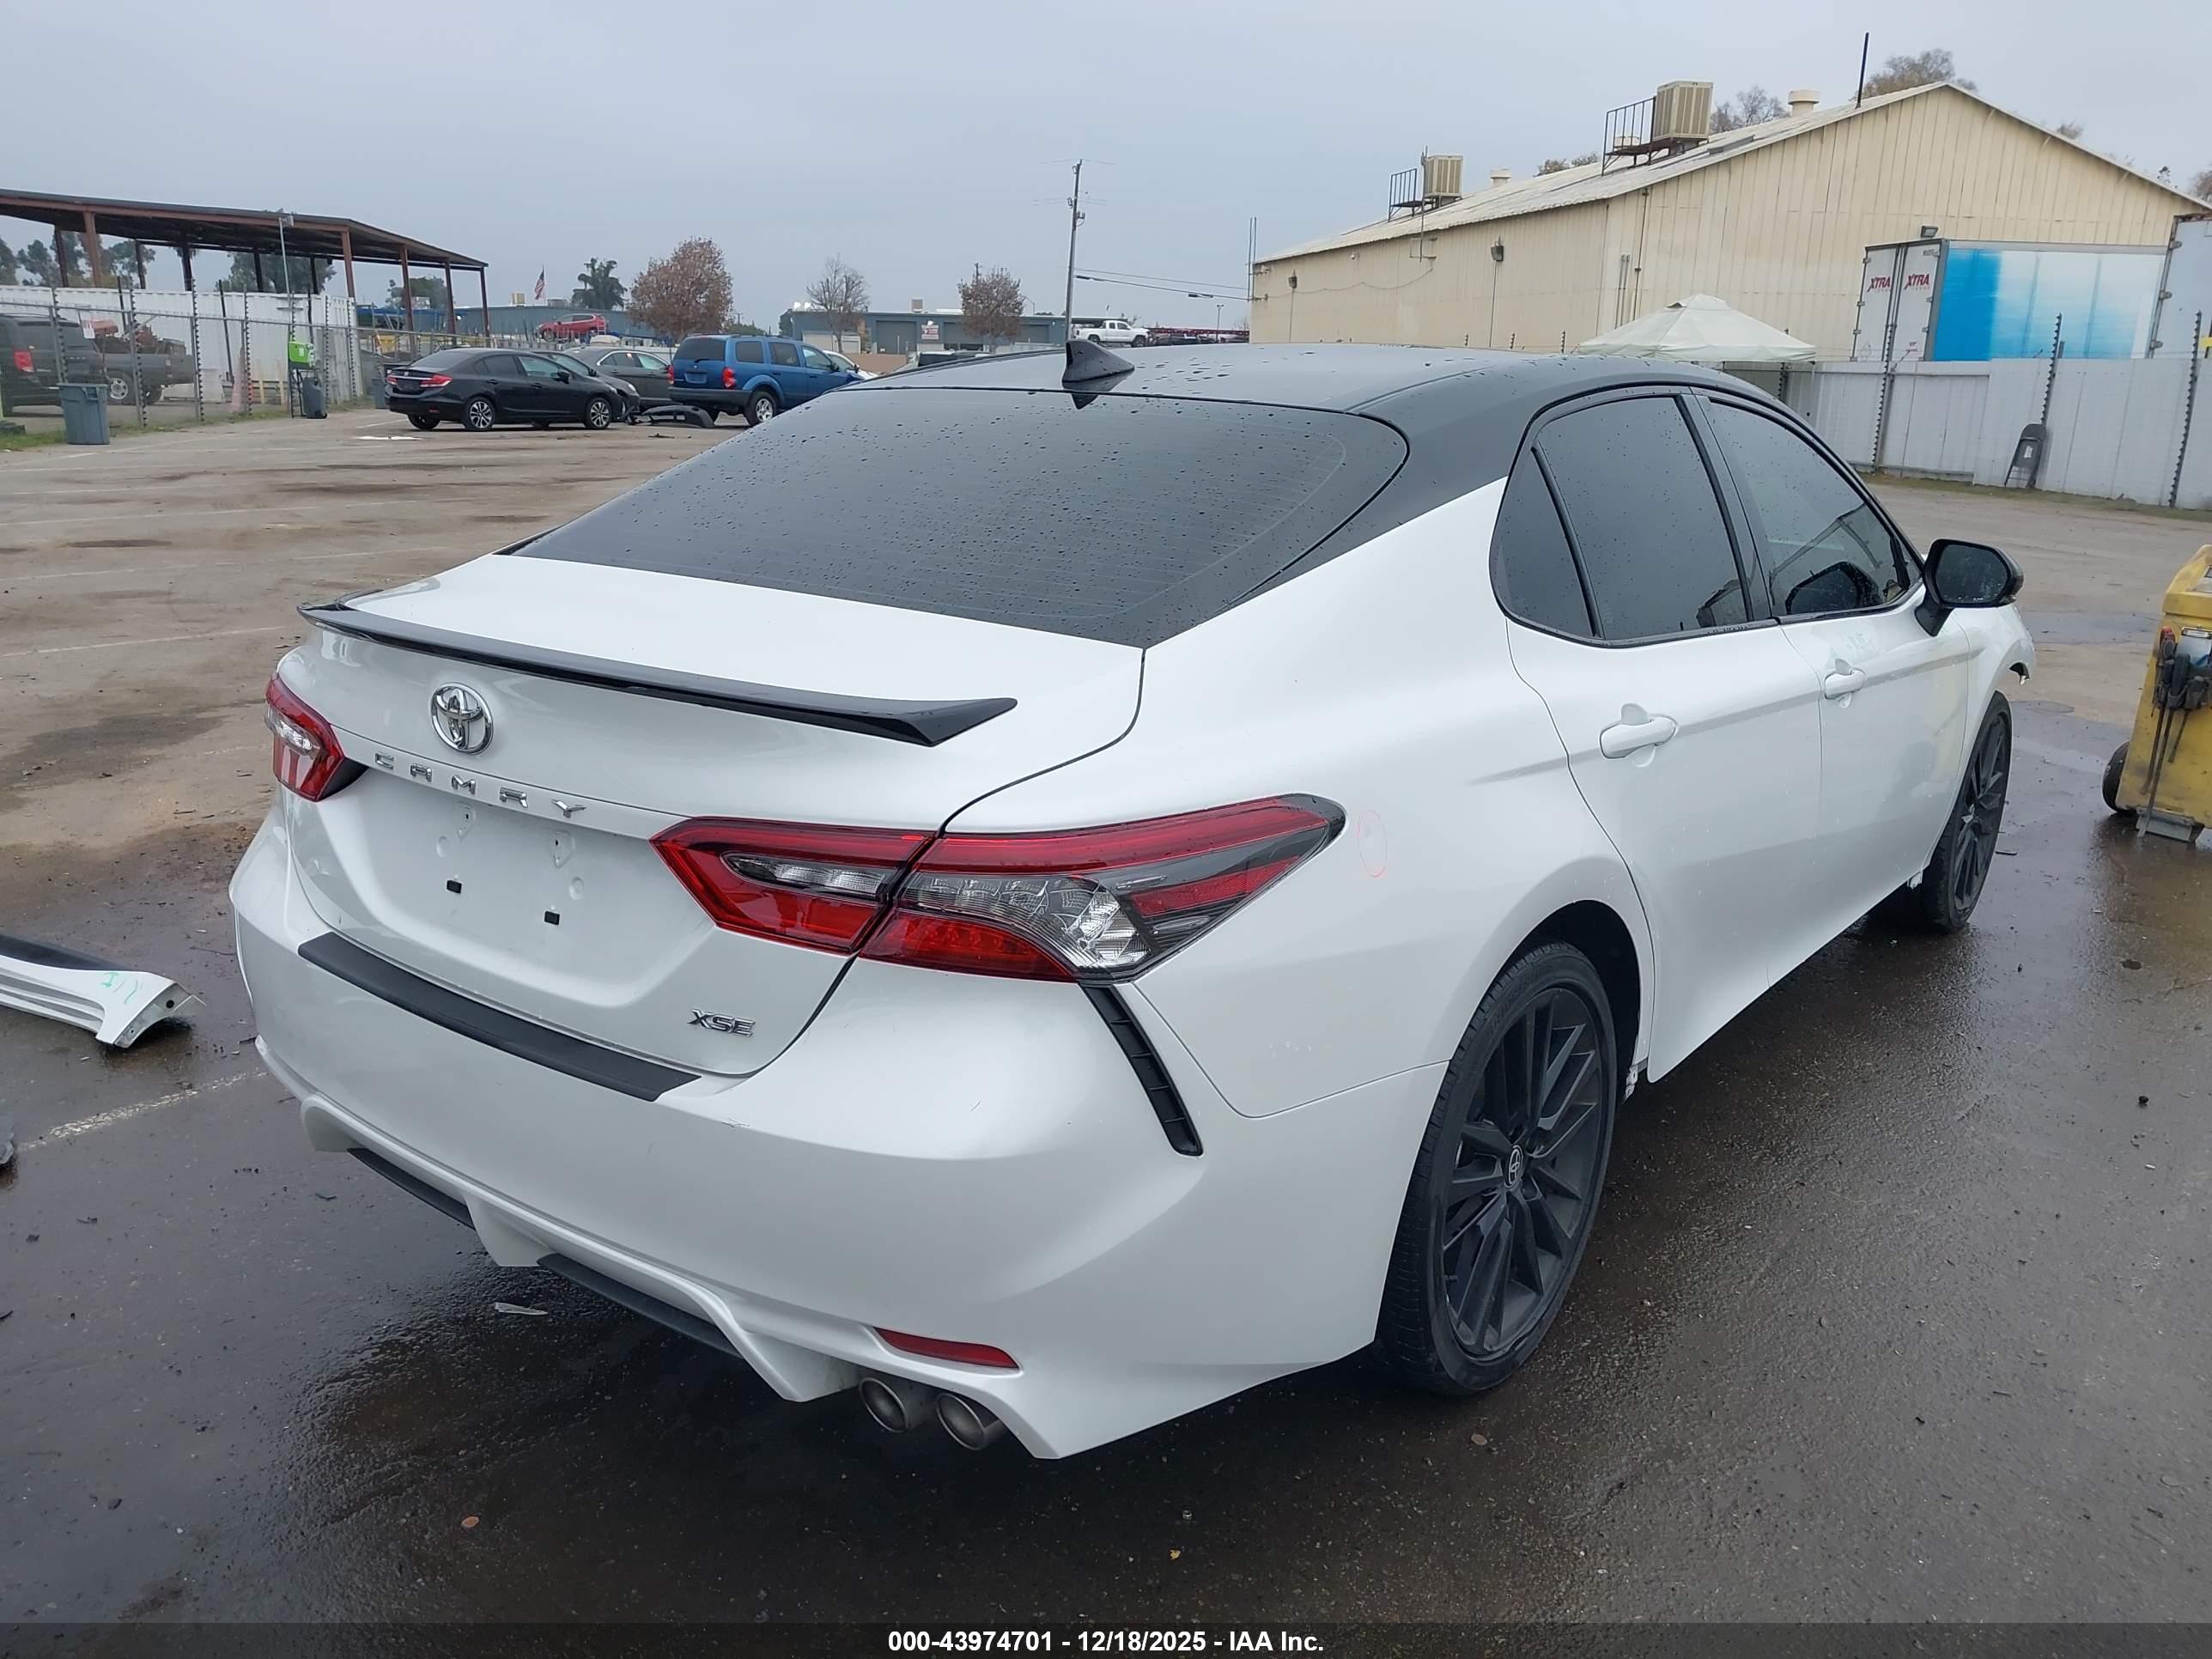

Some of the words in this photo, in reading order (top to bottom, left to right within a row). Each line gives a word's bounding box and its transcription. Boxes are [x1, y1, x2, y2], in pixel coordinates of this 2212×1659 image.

[1867, 276, 1892, 292] XTRA
[1904, 273, 1930, 290] XTRA
[374, 751, 587, 817] CAMRY
[687, 1008, 757, 1037] XSE
